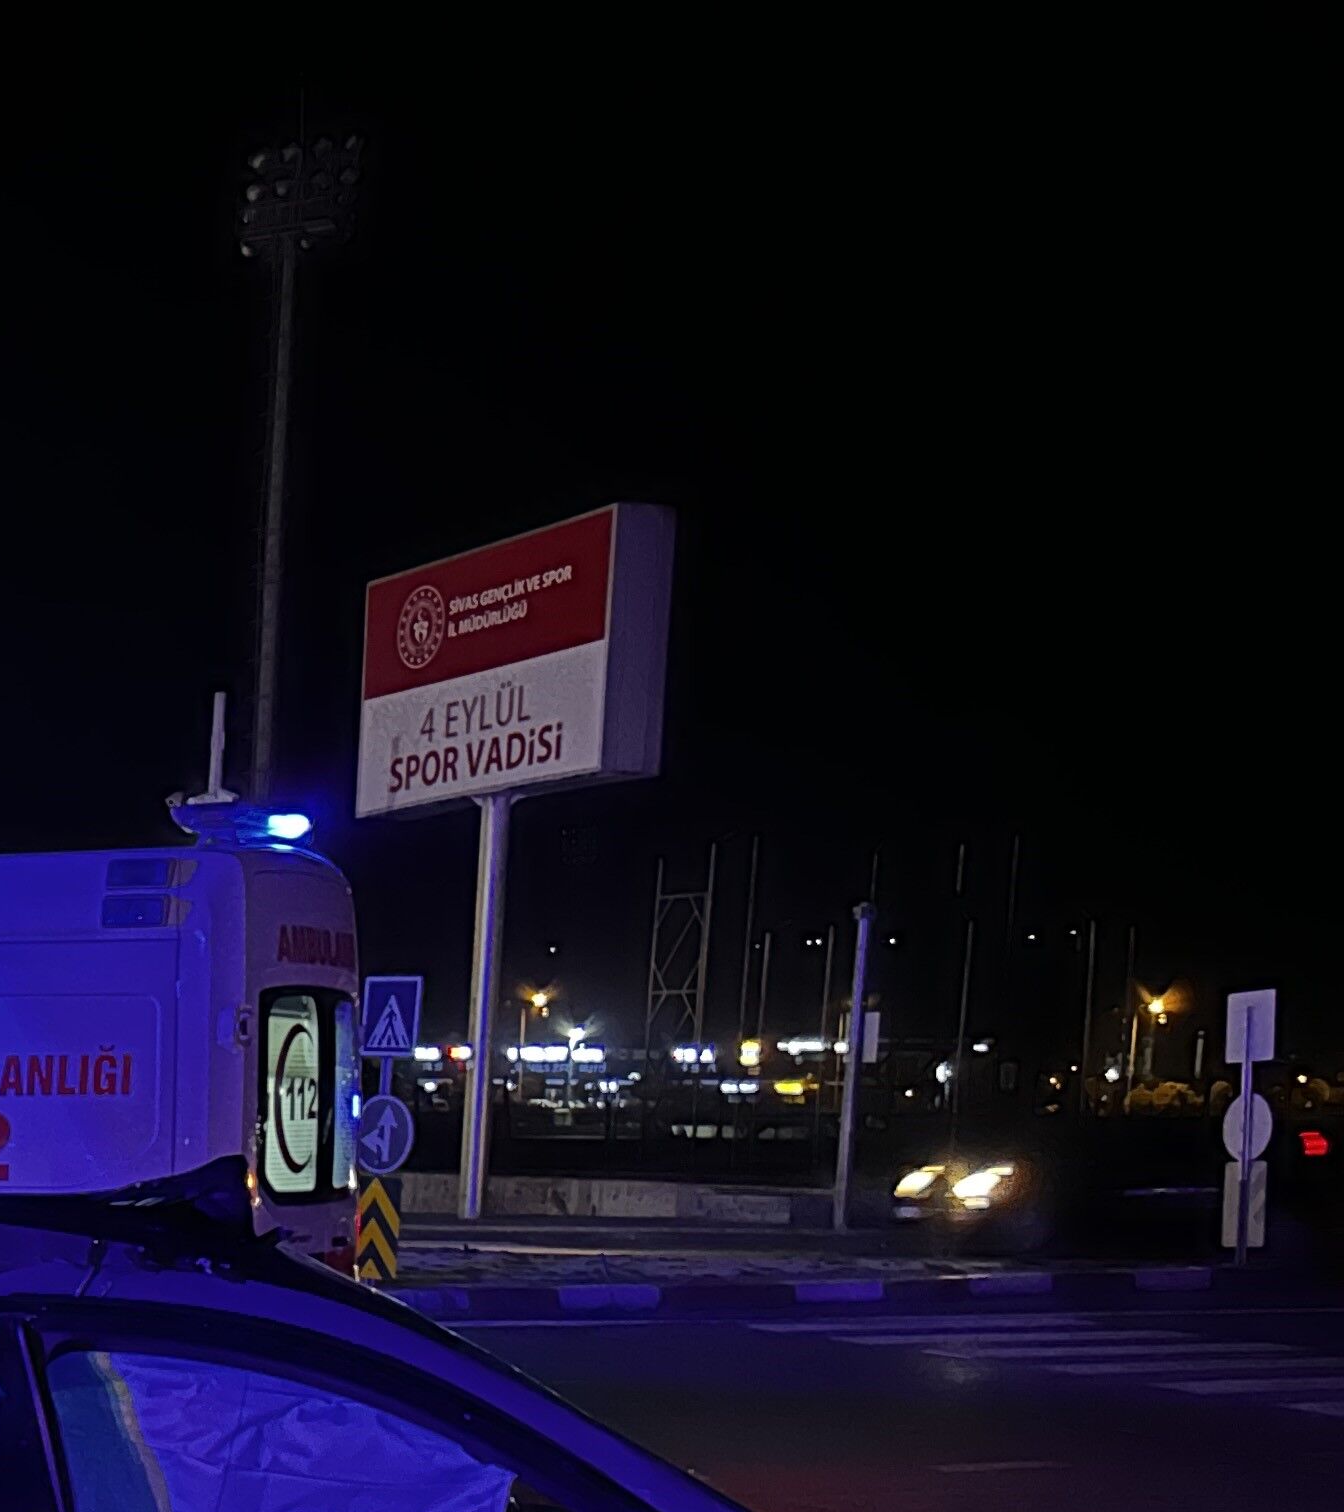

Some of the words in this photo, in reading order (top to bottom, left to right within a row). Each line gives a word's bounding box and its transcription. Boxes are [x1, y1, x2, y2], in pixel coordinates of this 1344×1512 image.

[449, 596, 479, 616] SİVAS
[480, 579, 526, 603] GENÇLİK
[526, 574, 541, 593] VE
[542, 565, 572, 588] SPOR
[458, 599, 528, 635] MÜDÜRLÜĞÜ
[420, 707, 435, 743] 4
[445, 680, 531, 738] EYLÜL
[388, 746, 459, 793] SPOR
[287, 1077, 316, 1121] 112
